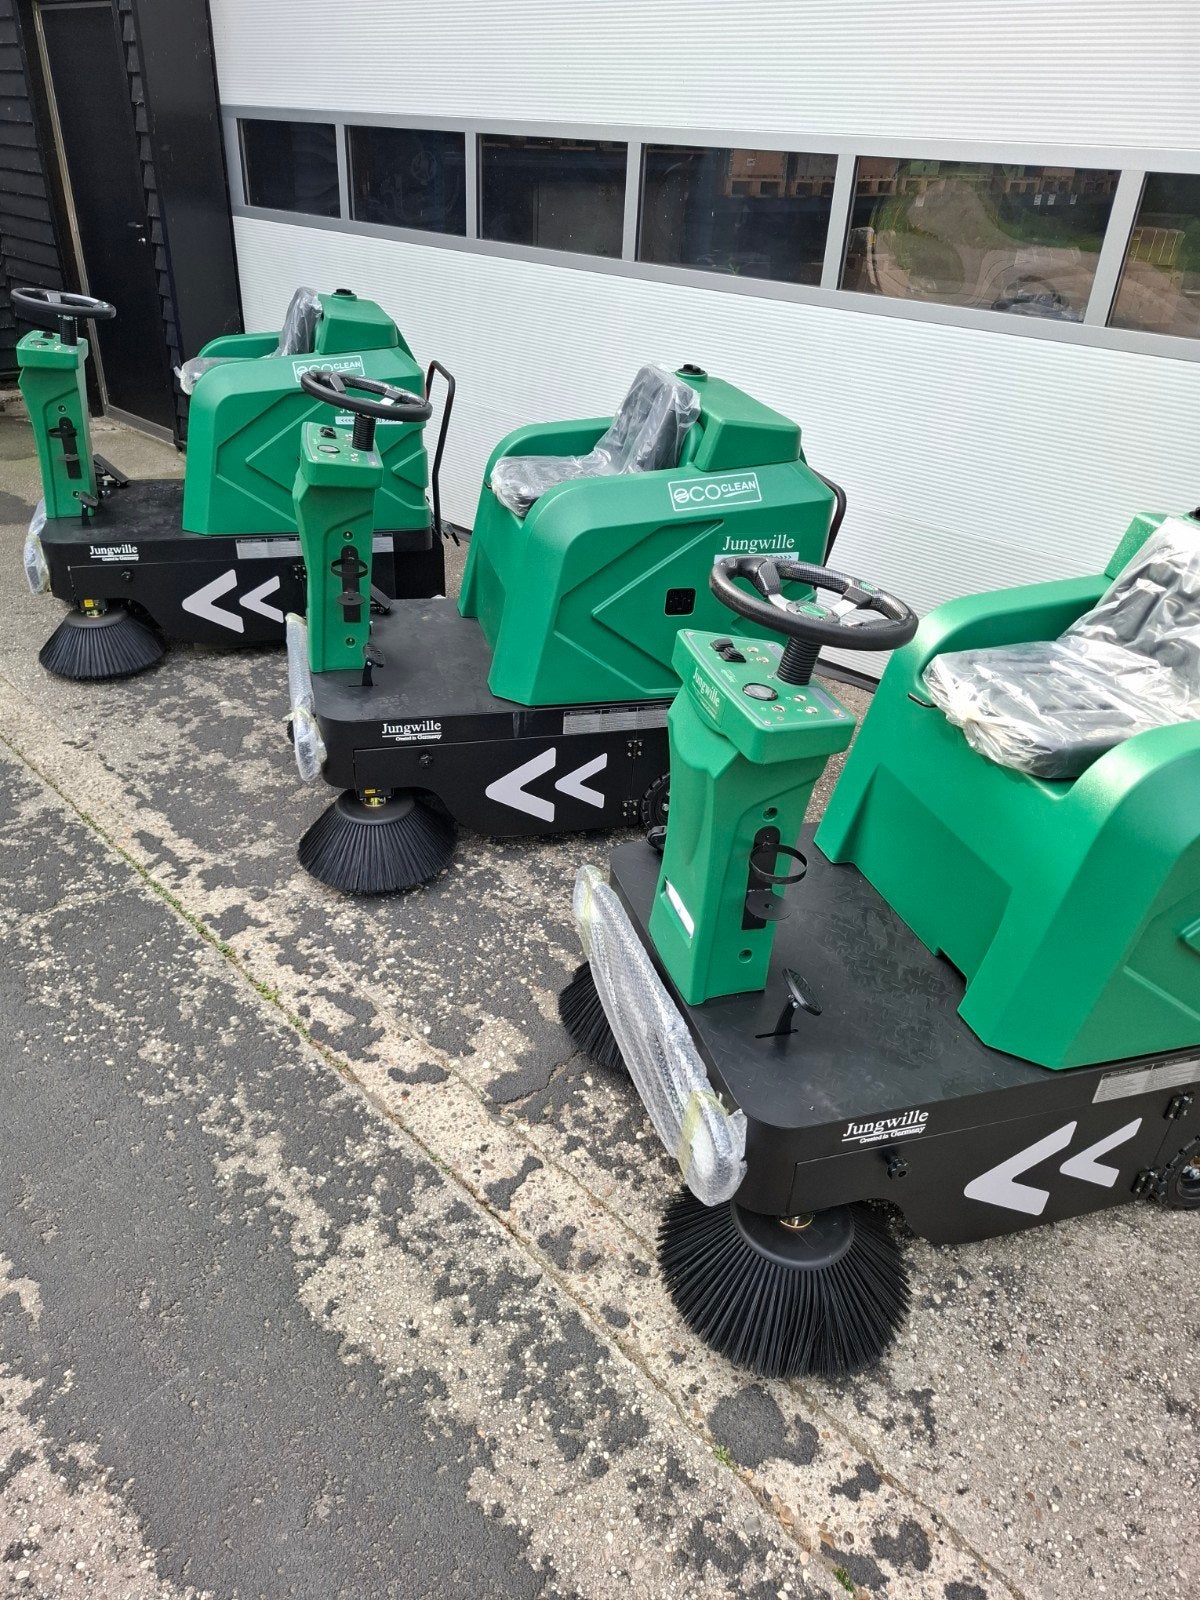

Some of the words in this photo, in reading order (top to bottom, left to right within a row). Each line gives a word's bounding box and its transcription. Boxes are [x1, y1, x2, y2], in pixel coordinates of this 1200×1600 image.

[720, 480, 757, 493] CLEAN
[89, 544, 138, 556] Jungwille
[722, 534, 795, 554] Jungwille
[381, 720, 442, 736] Jungwille
[842, 1110, 929, 1137] Jungwille
[890, 1126, 926, 1138] Germany
